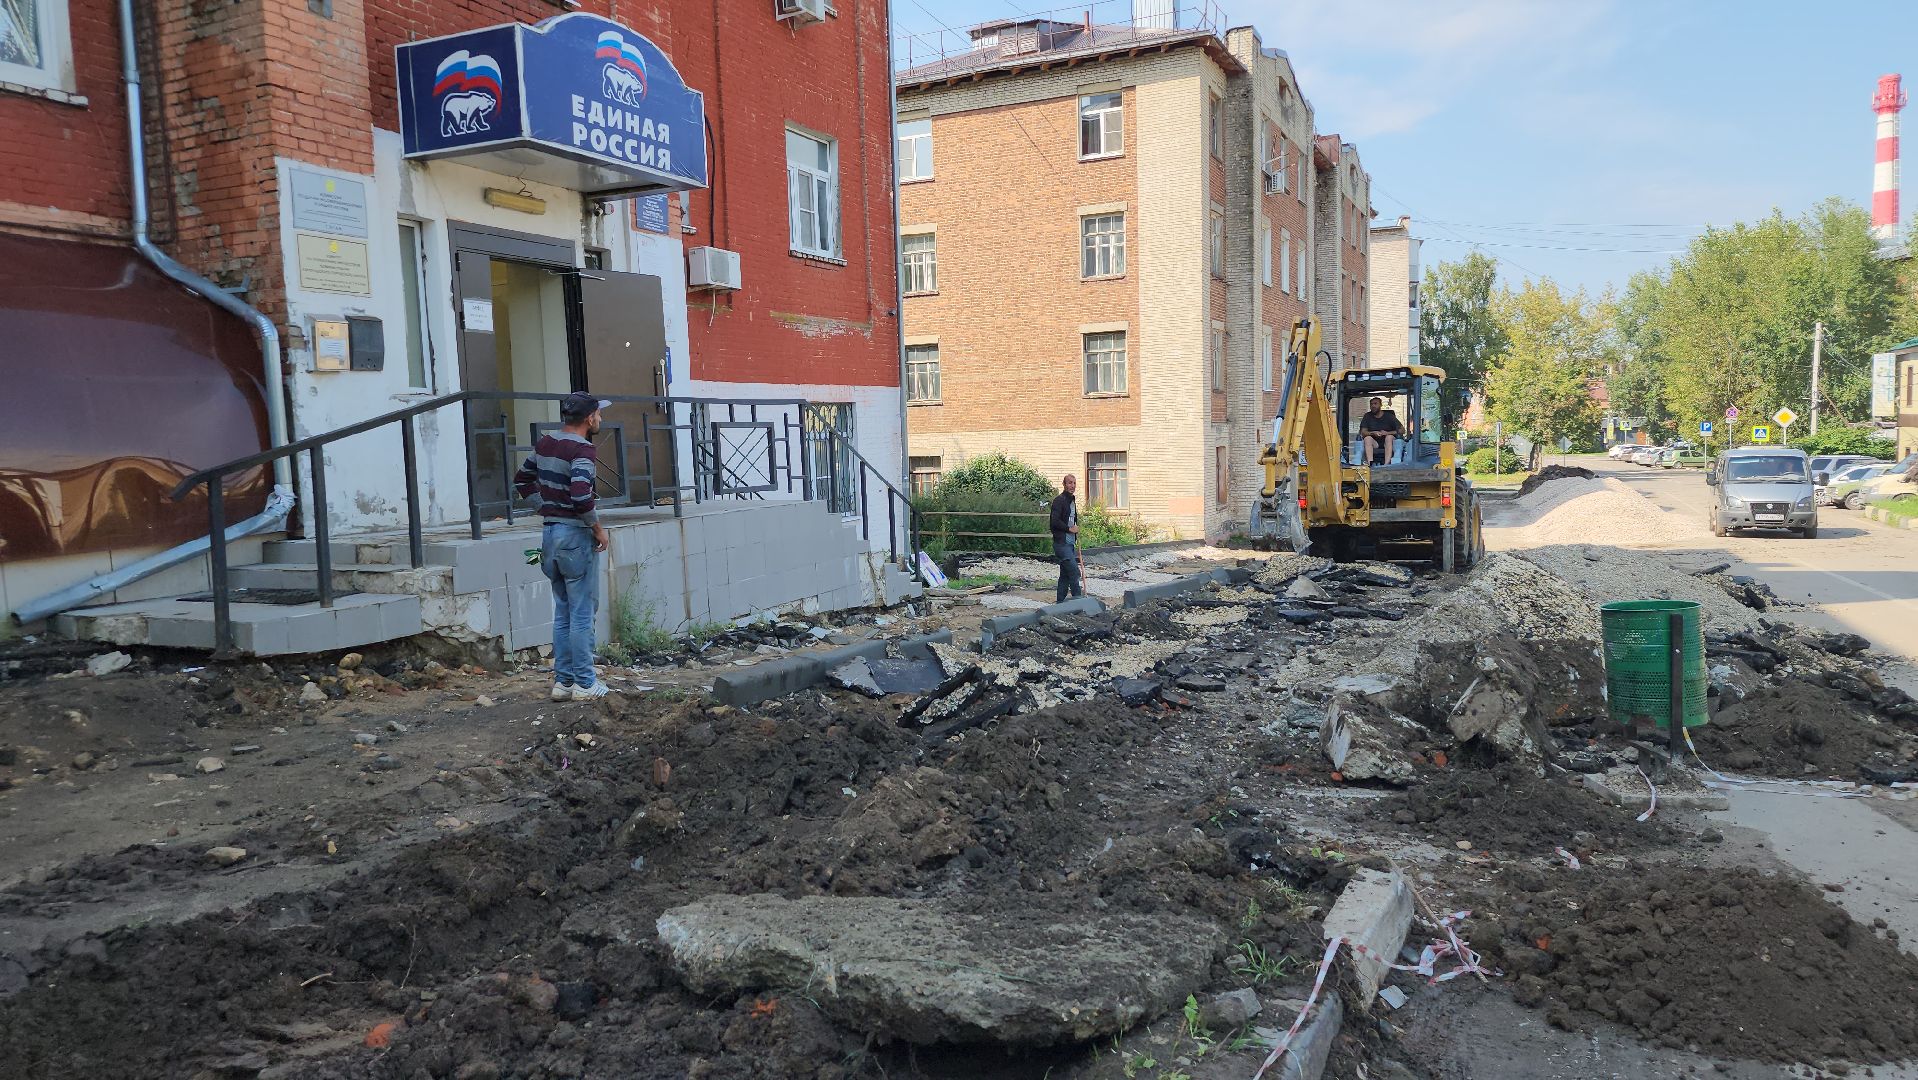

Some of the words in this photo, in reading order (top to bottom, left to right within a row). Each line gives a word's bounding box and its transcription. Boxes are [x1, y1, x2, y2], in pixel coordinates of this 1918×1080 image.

[571, 93, 670, 145] ЕДИНАЯ
[572, 121, 671, 171] РОССИЯ
[1703, 422, 1711, 431] P
